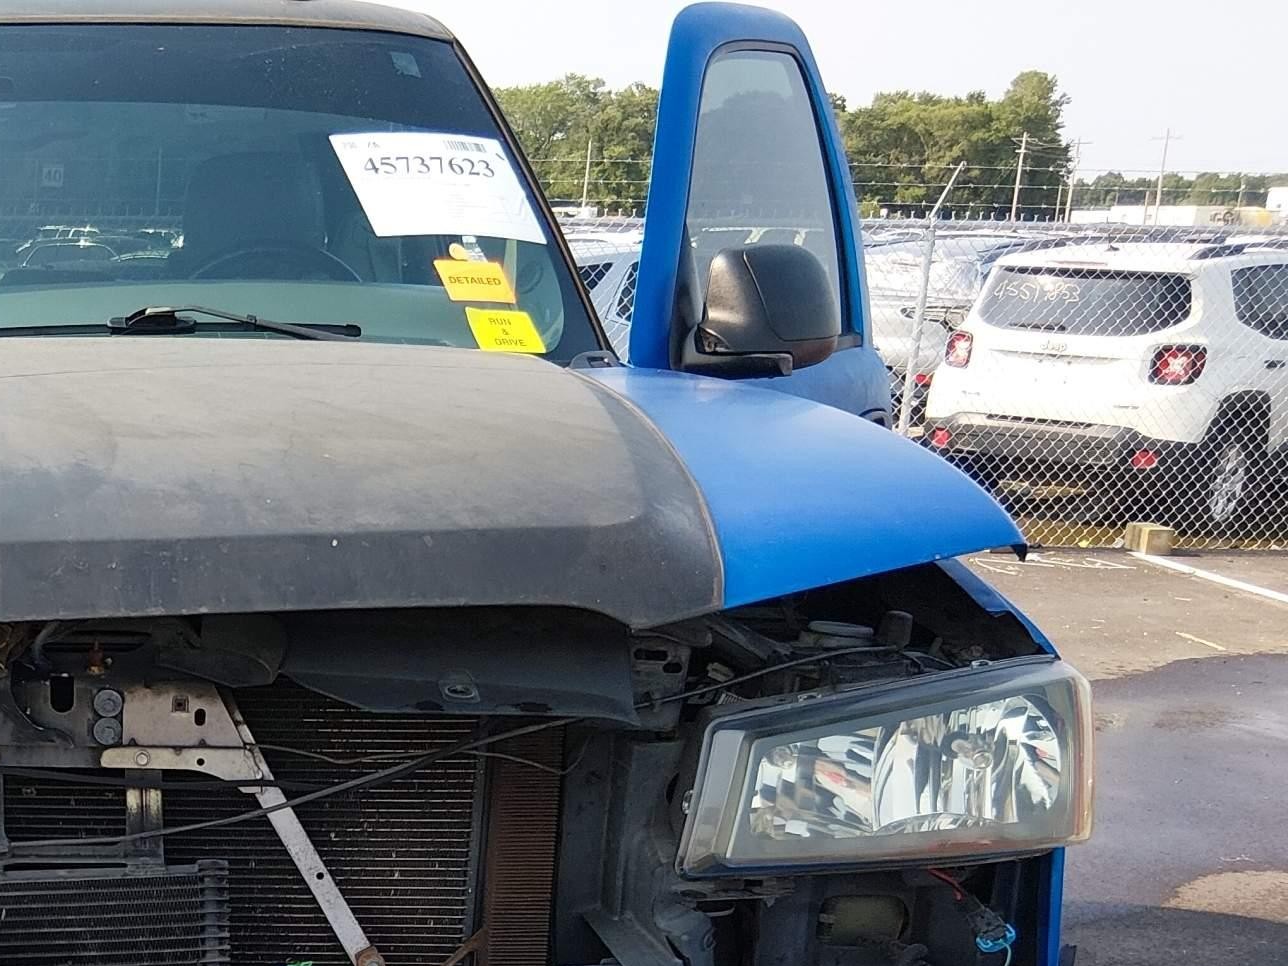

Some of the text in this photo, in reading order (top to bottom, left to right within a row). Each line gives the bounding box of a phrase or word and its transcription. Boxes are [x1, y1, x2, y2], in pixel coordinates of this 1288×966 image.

[363, 156, 496, 178] 45737623
[448, 276, 502, 286] DETAILED
[488, 317, 512, 326] RUN
[501, 328, 510, 336] &
[494, 338, 527, 347] DRIVE
